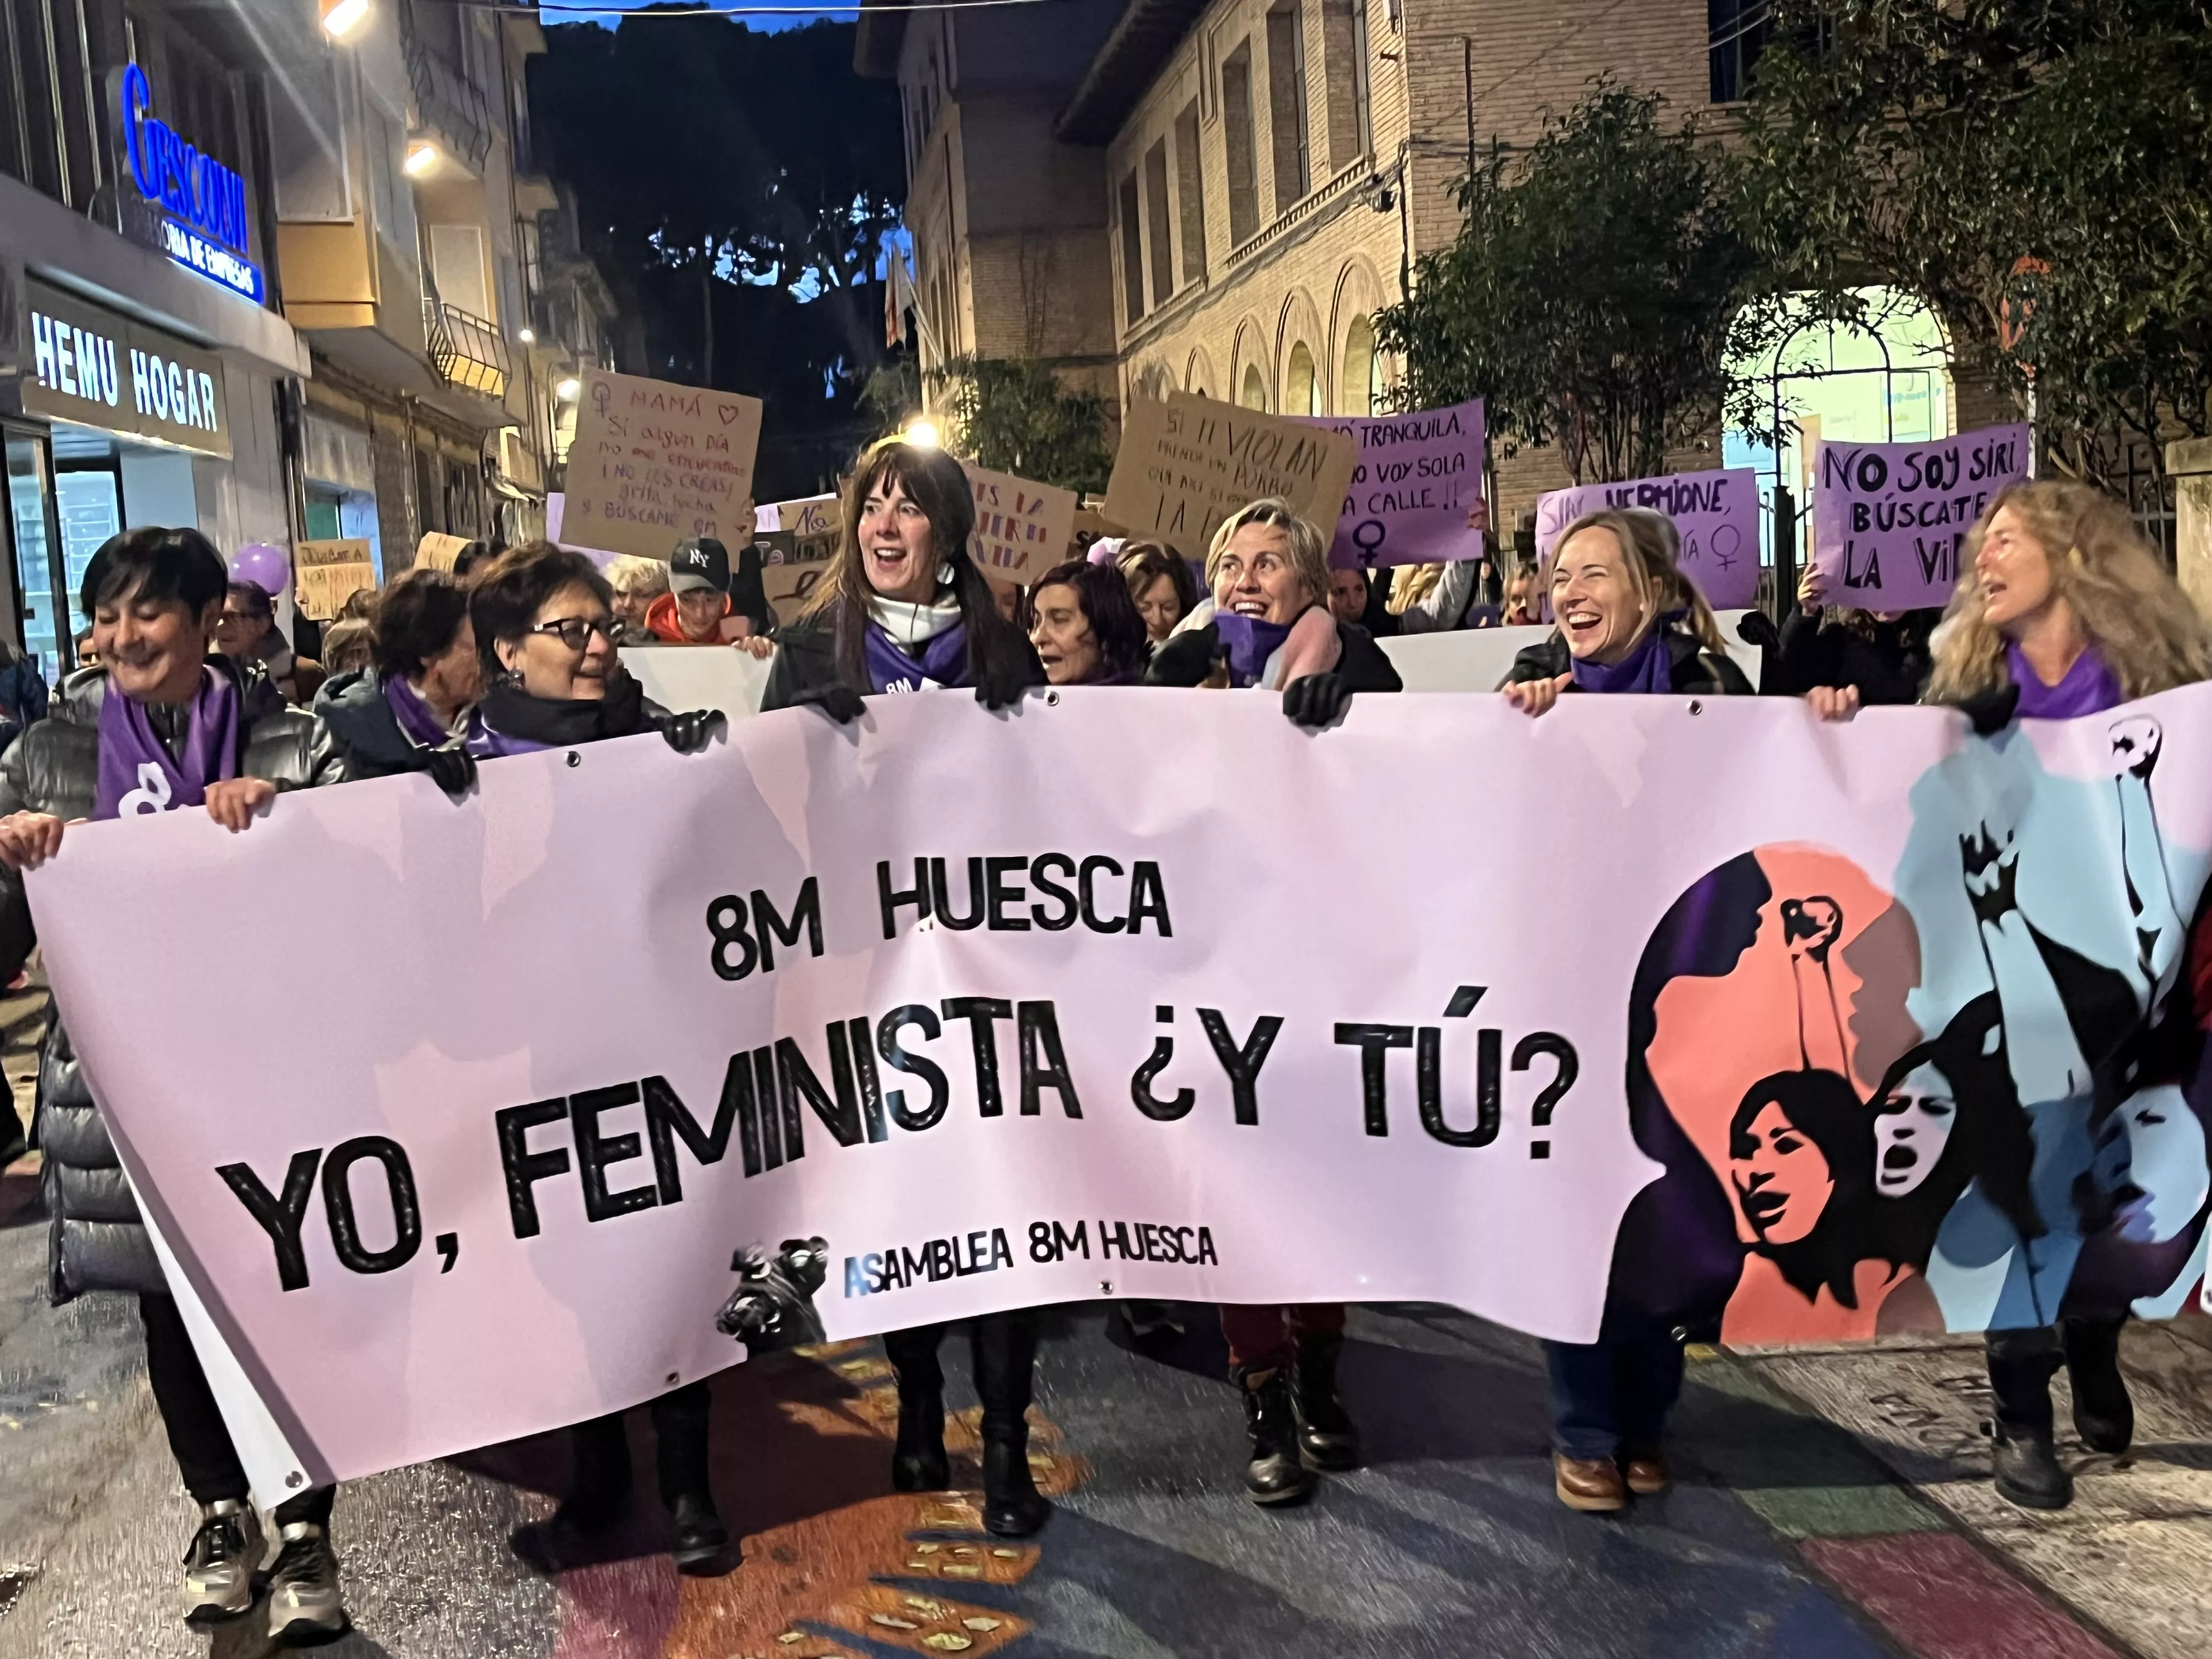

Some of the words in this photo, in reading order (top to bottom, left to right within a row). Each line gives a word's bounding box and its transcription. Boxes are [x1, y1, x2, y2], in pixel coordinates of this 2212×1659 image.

[190, 235, 206, 270] DE
[32, 312, 118, 407] HEMU
[130, 348, 217, 432] HOGAR
[1228, 421, 1328, 482] VIOLAN
[1361, 411, 1466, 449] TRANQUILA,
[1376, 462, 1413, 483] VOY
[1418, 452, 1465, 477] SOLA
[1822, 447, 1888, 493] NO
[1898, 446, 1960, 492] SOY
[1849, 492, 1988, 533] BÚSCATE
[690, 549, 709, 568] NY
[1842, 539, 1882, 590] LA
[706, 876, 824, 981] 8M
[876, 852, 1173, 940] HUESCA
[215, 1134, 460, 1292] YO,
[494, 996, 1084, 1240] FEMINISTA
[1130, 1005, 1285, 1126] ¿Y
[1334, 985, 1579, 1159] TÚ?
[844, 1227, 1014, 1298] ASAMBLEA
[1028, 1220, 1091, 1263] 8M
[1099, 1220, 1219, 1266] HUESCA
